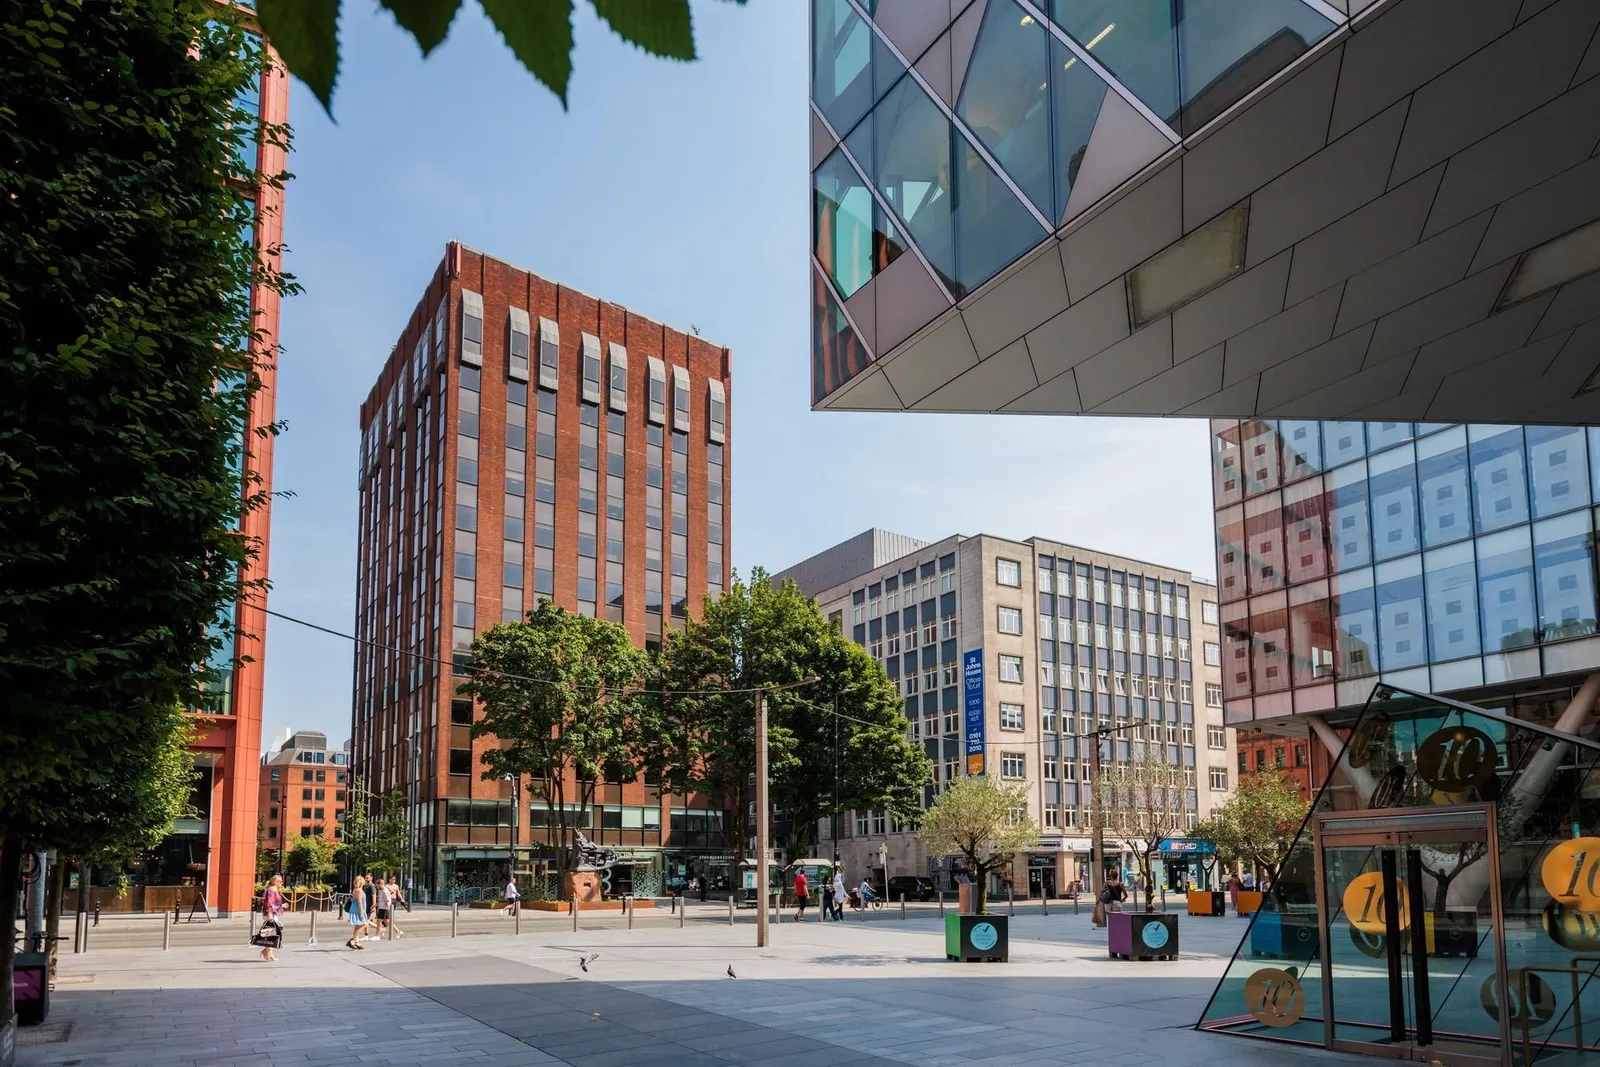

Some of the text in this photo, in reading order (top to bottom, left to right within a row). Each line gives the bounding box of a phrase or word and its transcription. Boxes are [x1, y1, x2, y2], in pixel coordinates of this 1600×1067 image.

[965, 669, 981, 677] House
[1430, 736, 1485, 782] 10
[1256, 979, 1296, 1017] 10
